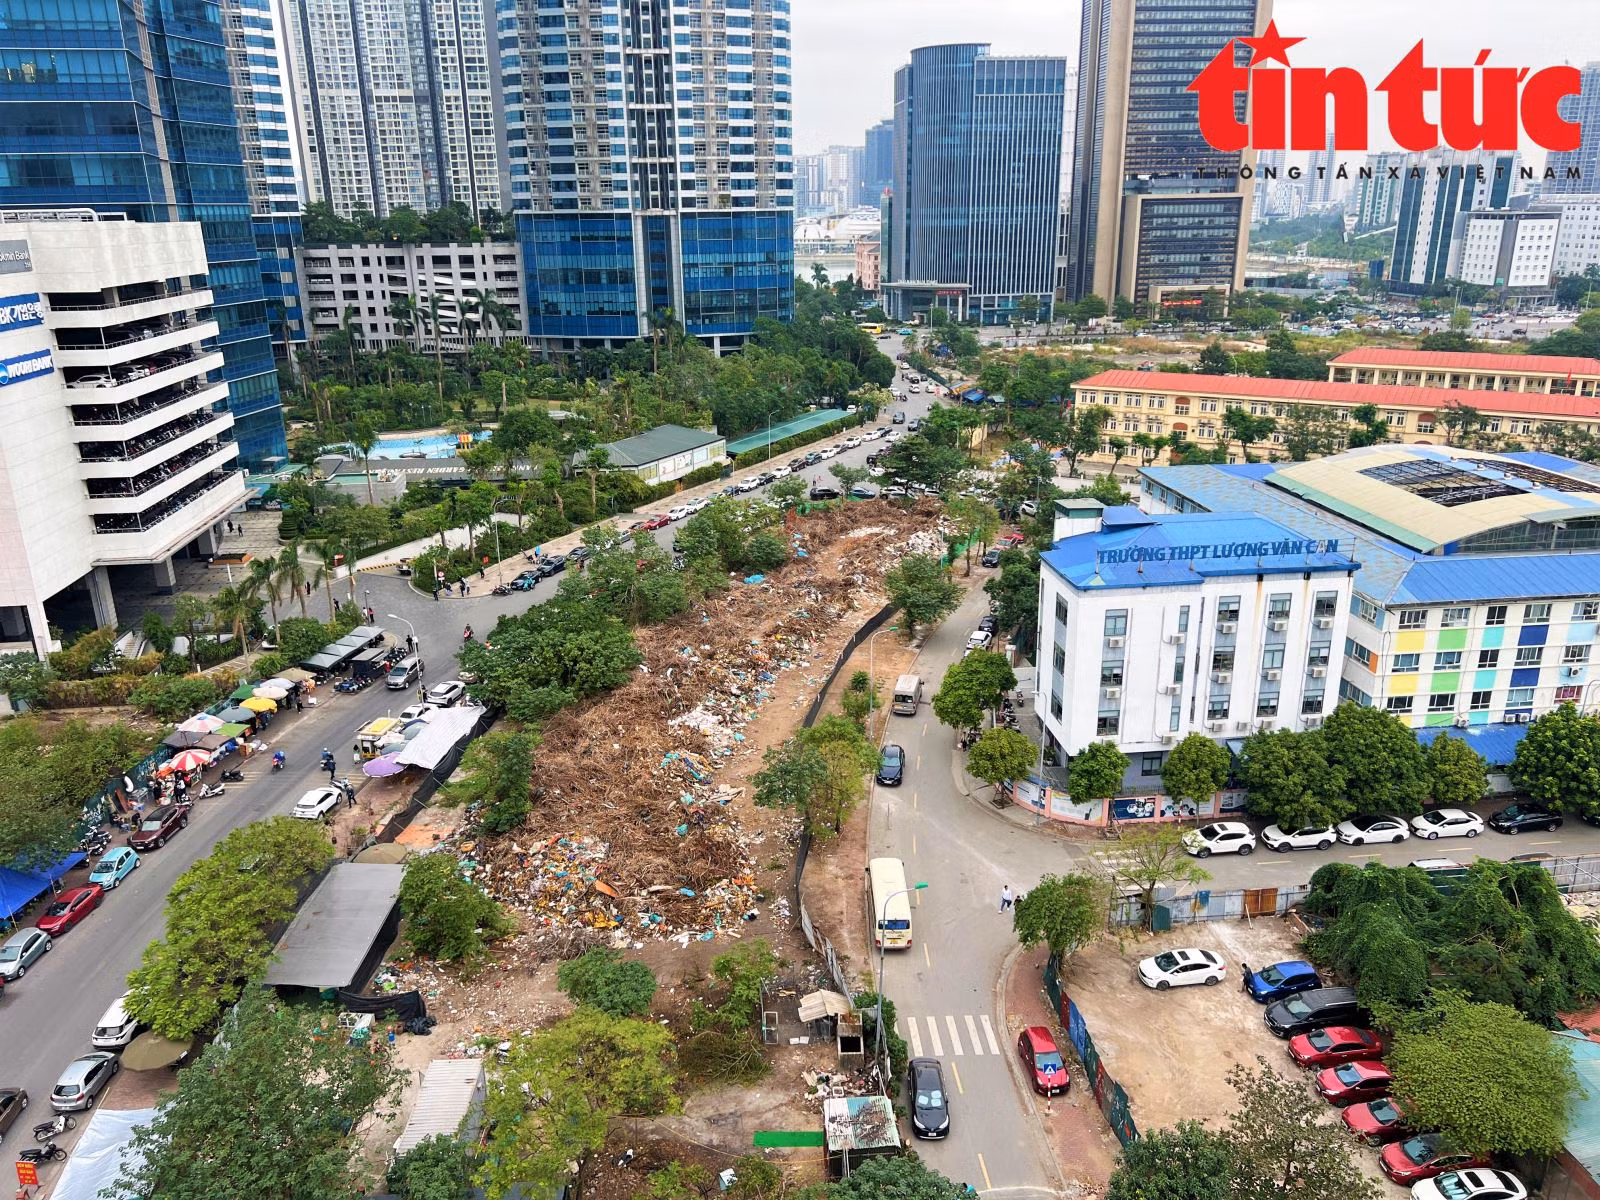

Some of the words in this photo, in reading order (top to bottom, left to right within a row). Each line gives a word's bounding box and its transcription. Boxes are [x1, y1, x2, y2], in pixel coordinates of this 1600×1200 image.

[15, 249, 30, 260] Bank
[32, 355, 53, 372] BANK
[1098, 545, 1166, 564] TRƯỜNG
[1168, 545, 1211, 560] THPT
[1271, 538, 1303, 555] VĂN
[1305, 539, 1339, 554] CAN
